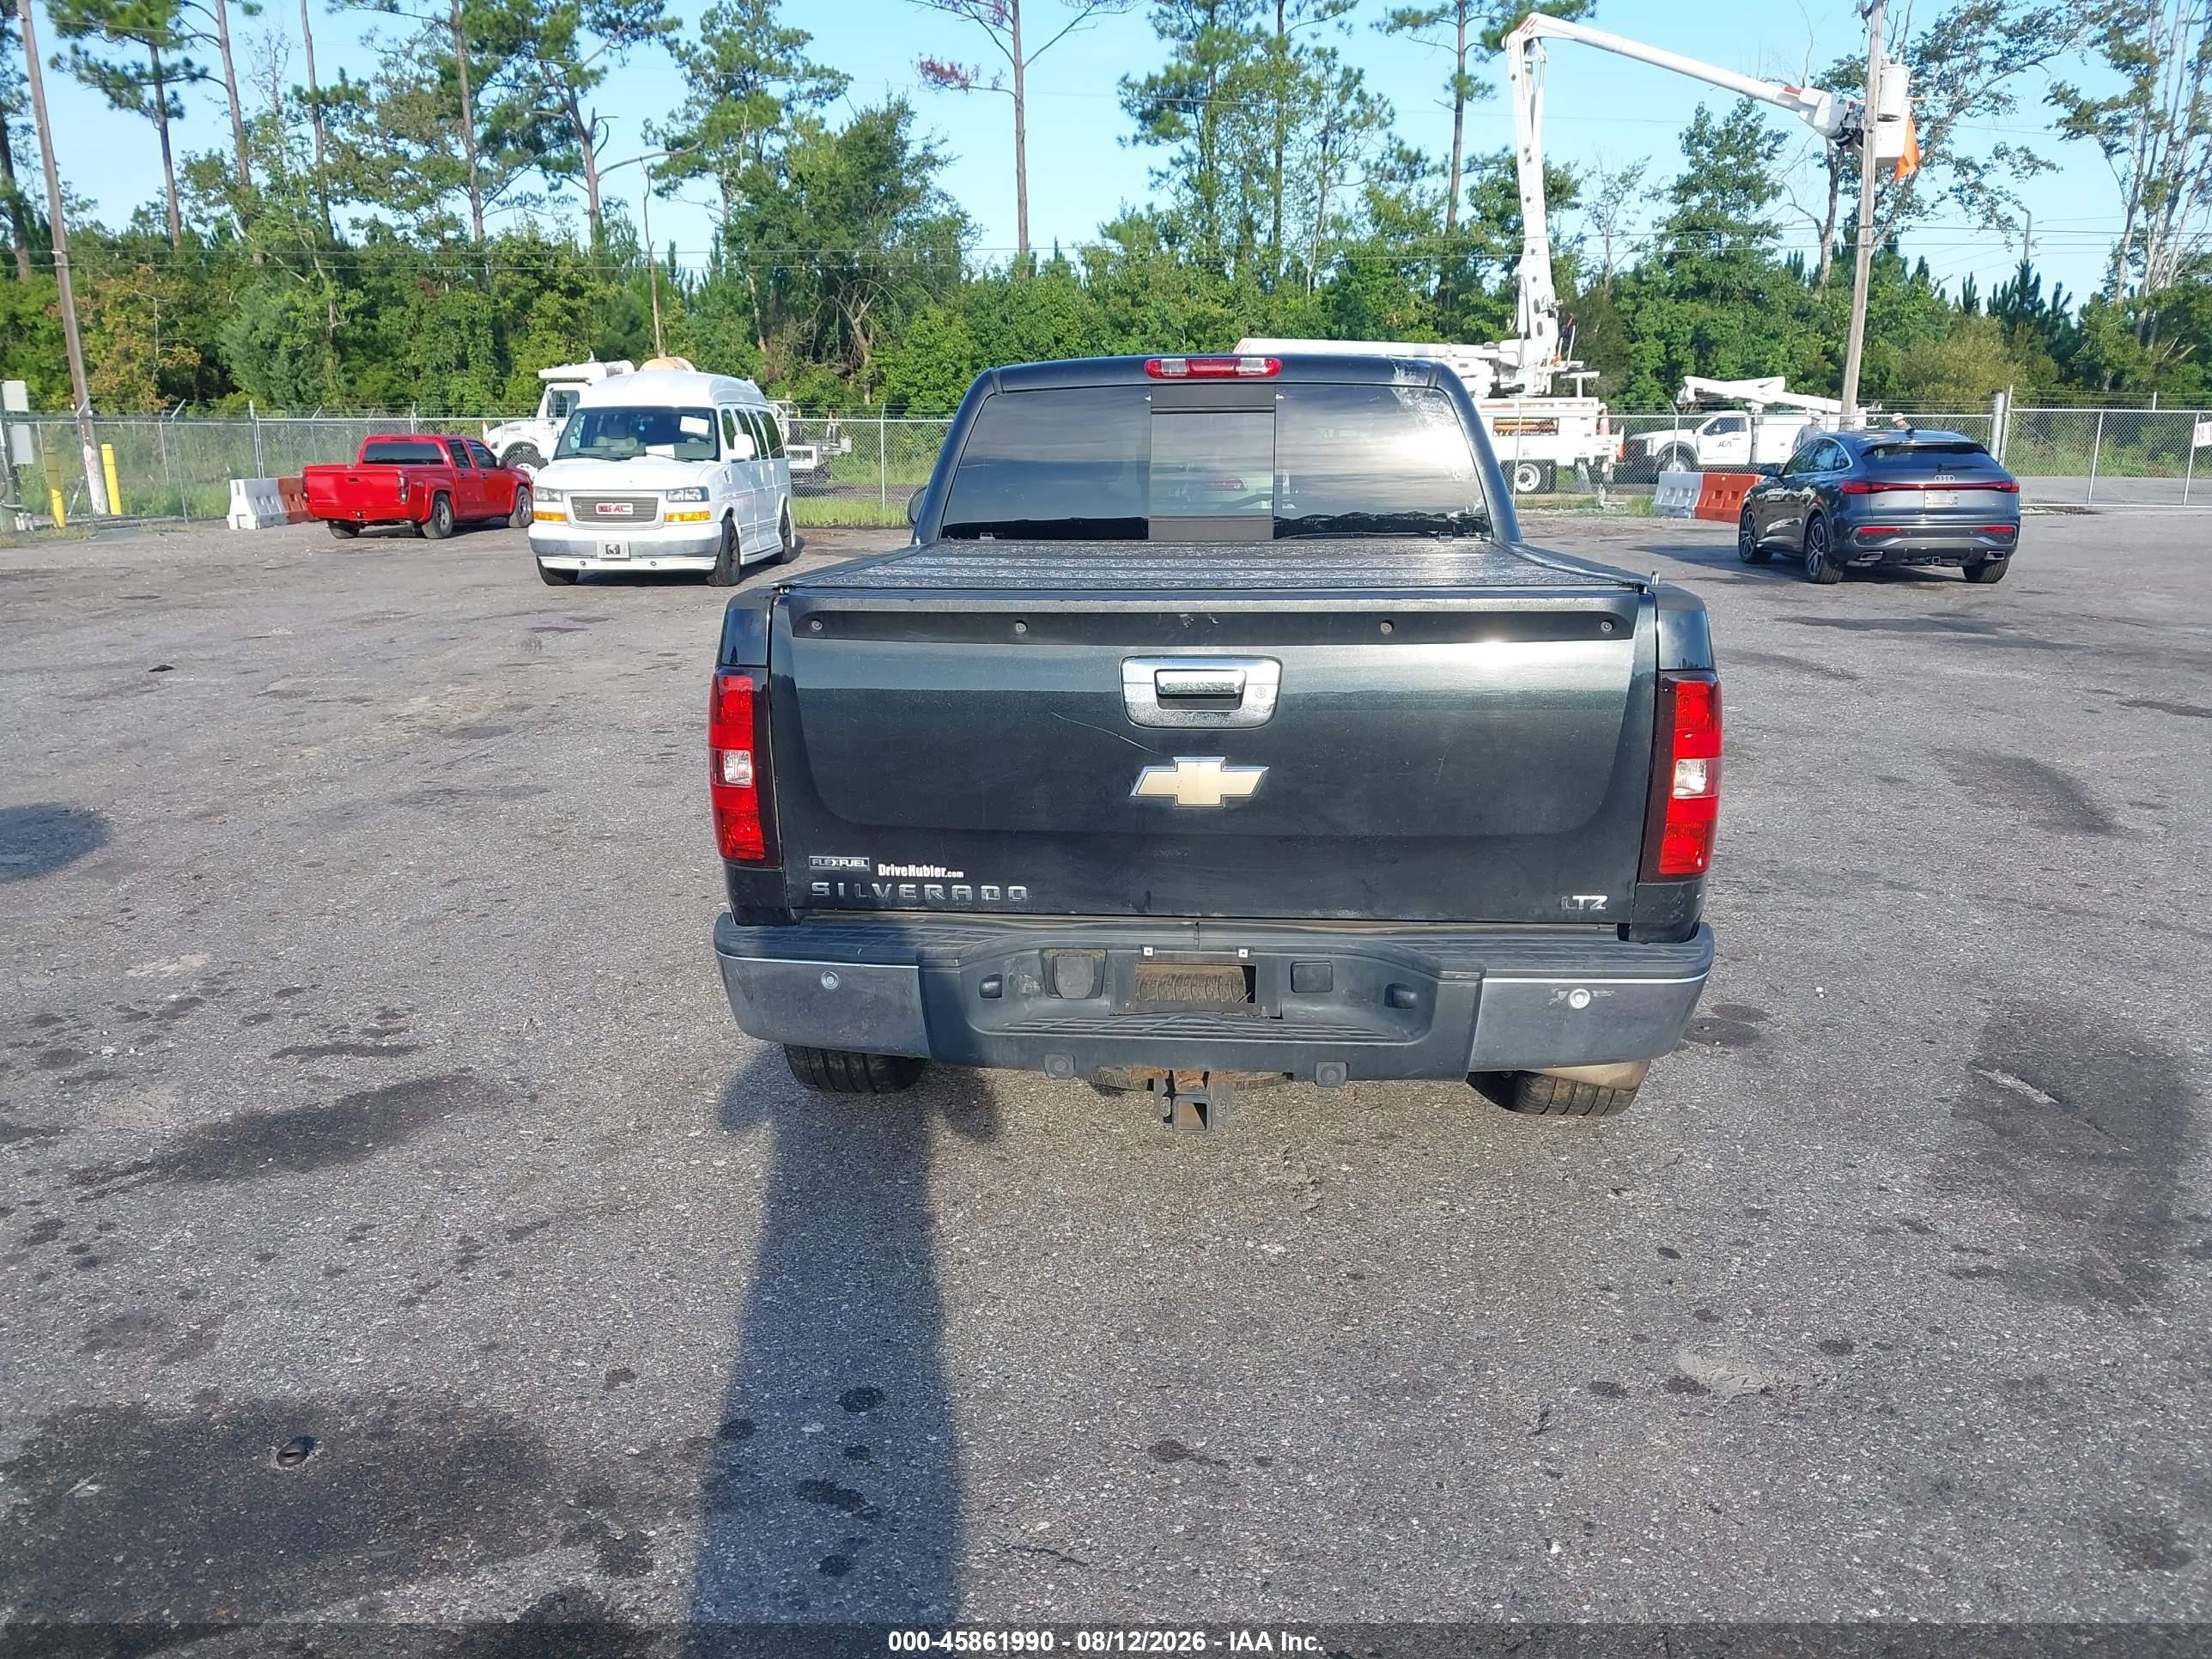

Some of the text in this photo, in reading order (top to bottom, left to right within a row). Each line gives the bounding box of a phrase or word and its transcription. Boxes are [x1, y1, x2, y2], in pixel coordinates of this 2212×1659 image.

[878, 863, 964, 878] DriveHubler.com
[811, 882, 1028, 902] SILVERADO
[1561, 895, 1607, 910] LTZ
